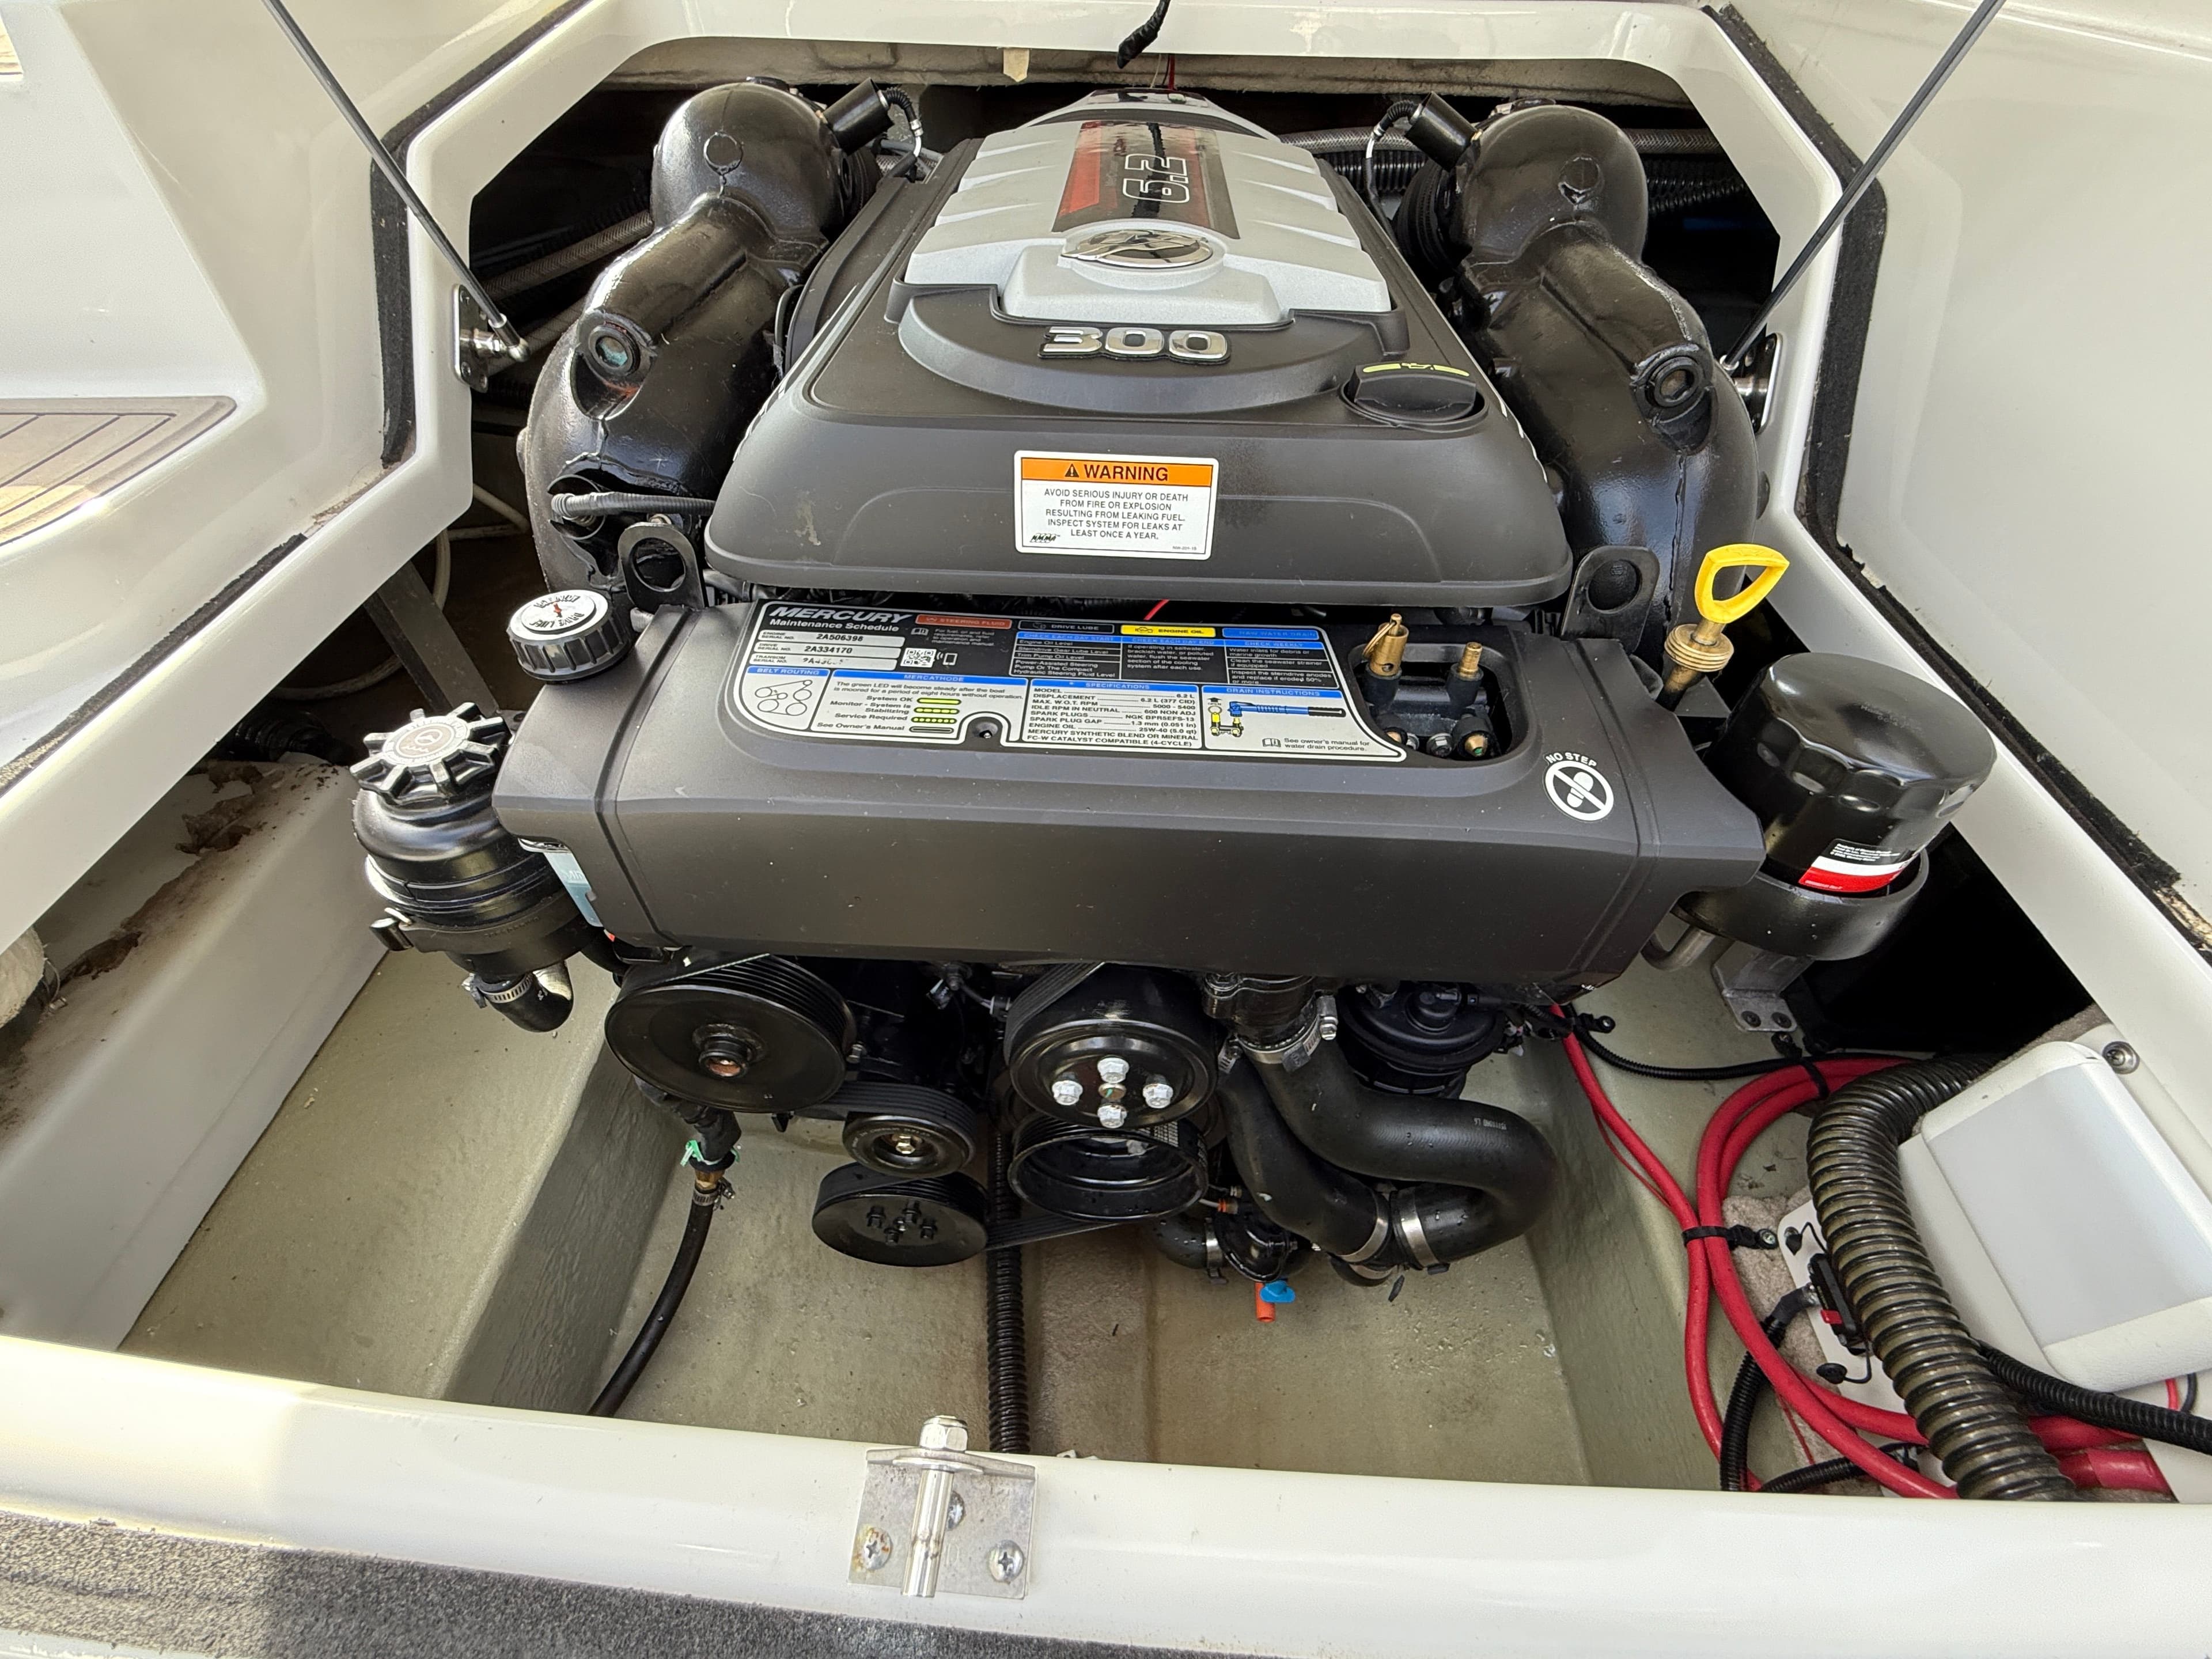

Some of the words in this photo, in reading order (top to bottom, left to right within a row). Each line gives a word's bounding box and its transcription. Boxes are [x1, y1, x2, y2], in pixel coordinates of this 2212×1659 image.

[1123, 153, 1190, 203] 6.2
[1042, 326, 1228, 359] 300
[1084, 464, 1168, 481] WARNING
[1044, 488, 1070, 497] AVOID
[1072, 490, 1109, 498] SERIOUS
[1112, 491, 1142, 500] INJURY
[1160, 493, 1188, 501] DEATH
[1060, 499, 1084, 507] FROM
[1123, 502, 1171, 510] EXPLOSION
[1046, 509, 1092, 518] RESULTING
[1095, 510, 1119, 519] FROM
[1122, 512, 1158, 520] LEAKING
[1161, 513, 1185, 521] FUEL.
[1048, 519, 1083, 527] INSPECT
[1086, 520, 1119, 528] SYSTEM
[1142, 522, 1169, 530] LEAKS
[1172, 523, 1183, 531] AT
[1071, 529, 1097, 537] LEAST
[1134, 532, 1158, 540] YEAR.
[770, 607, 912, 623] MERCURY
[770, 619, 842, 629] Maintenance
[845, 623, 899, 631] Schedule
[804, 646, 853, 654] 2A334170
[1546, 752, 1563, 763] NO
[1565, 752, 1597, 767] STEP
